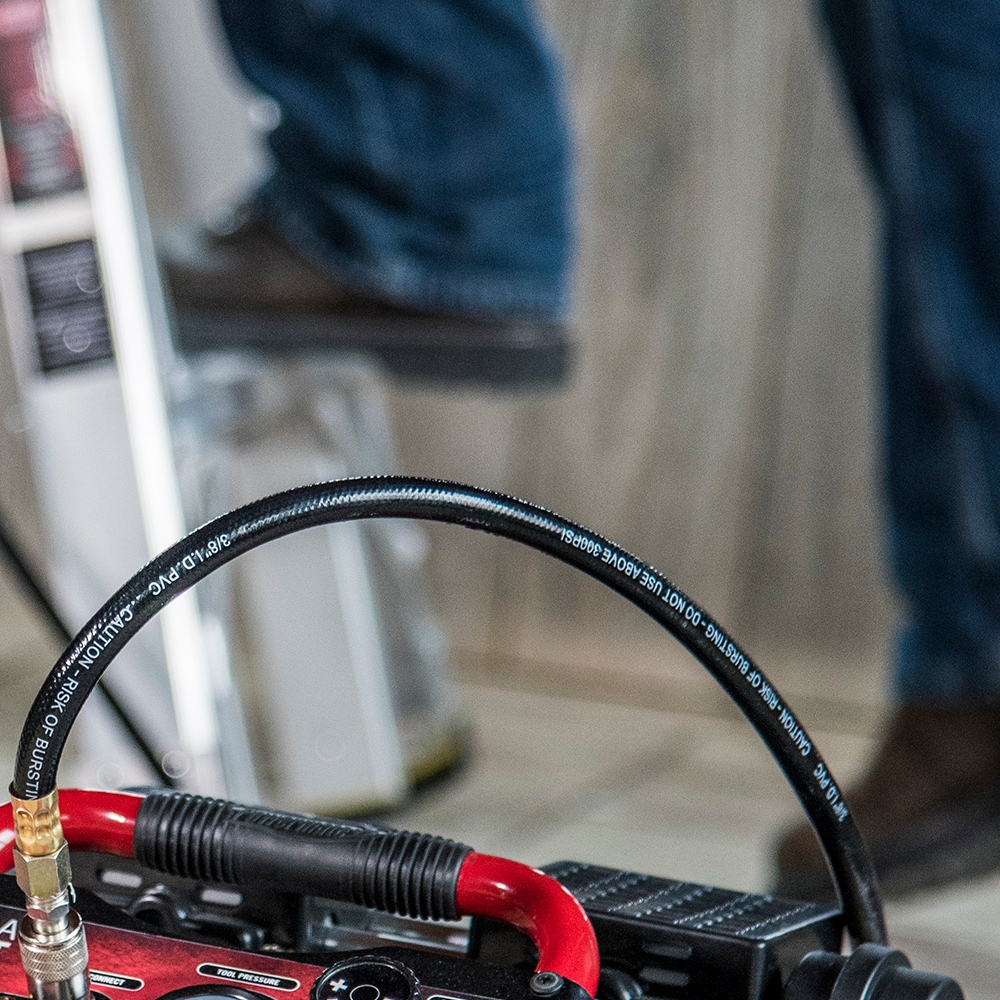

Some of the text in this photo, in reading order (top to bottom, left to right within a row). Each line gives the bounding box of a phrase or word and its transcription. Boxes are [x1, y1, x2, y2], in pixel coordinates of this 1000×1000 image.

[601, 547, 641, 580] ABOVE
[149, 566, 180, 596] PVC
[639, 571, 663, 596] USE
[662, 588, 686, 613] NOT
[685, 606, 701, 626] DO
[78, 607, 134, 670] CAUTION
[705, 625, 750, 674] BURSTING
[746, 670, 761, 688] OF
[51, 676, 80, 713] RISK
[758, 681, 780, 710] RISK
[42, 714, 58, 737] OF
[779, 708, 812, 756] CAUTION
[813, 763, 831, 789] PVC
[217, 968, 281, 987] TOOL PRESSURE
